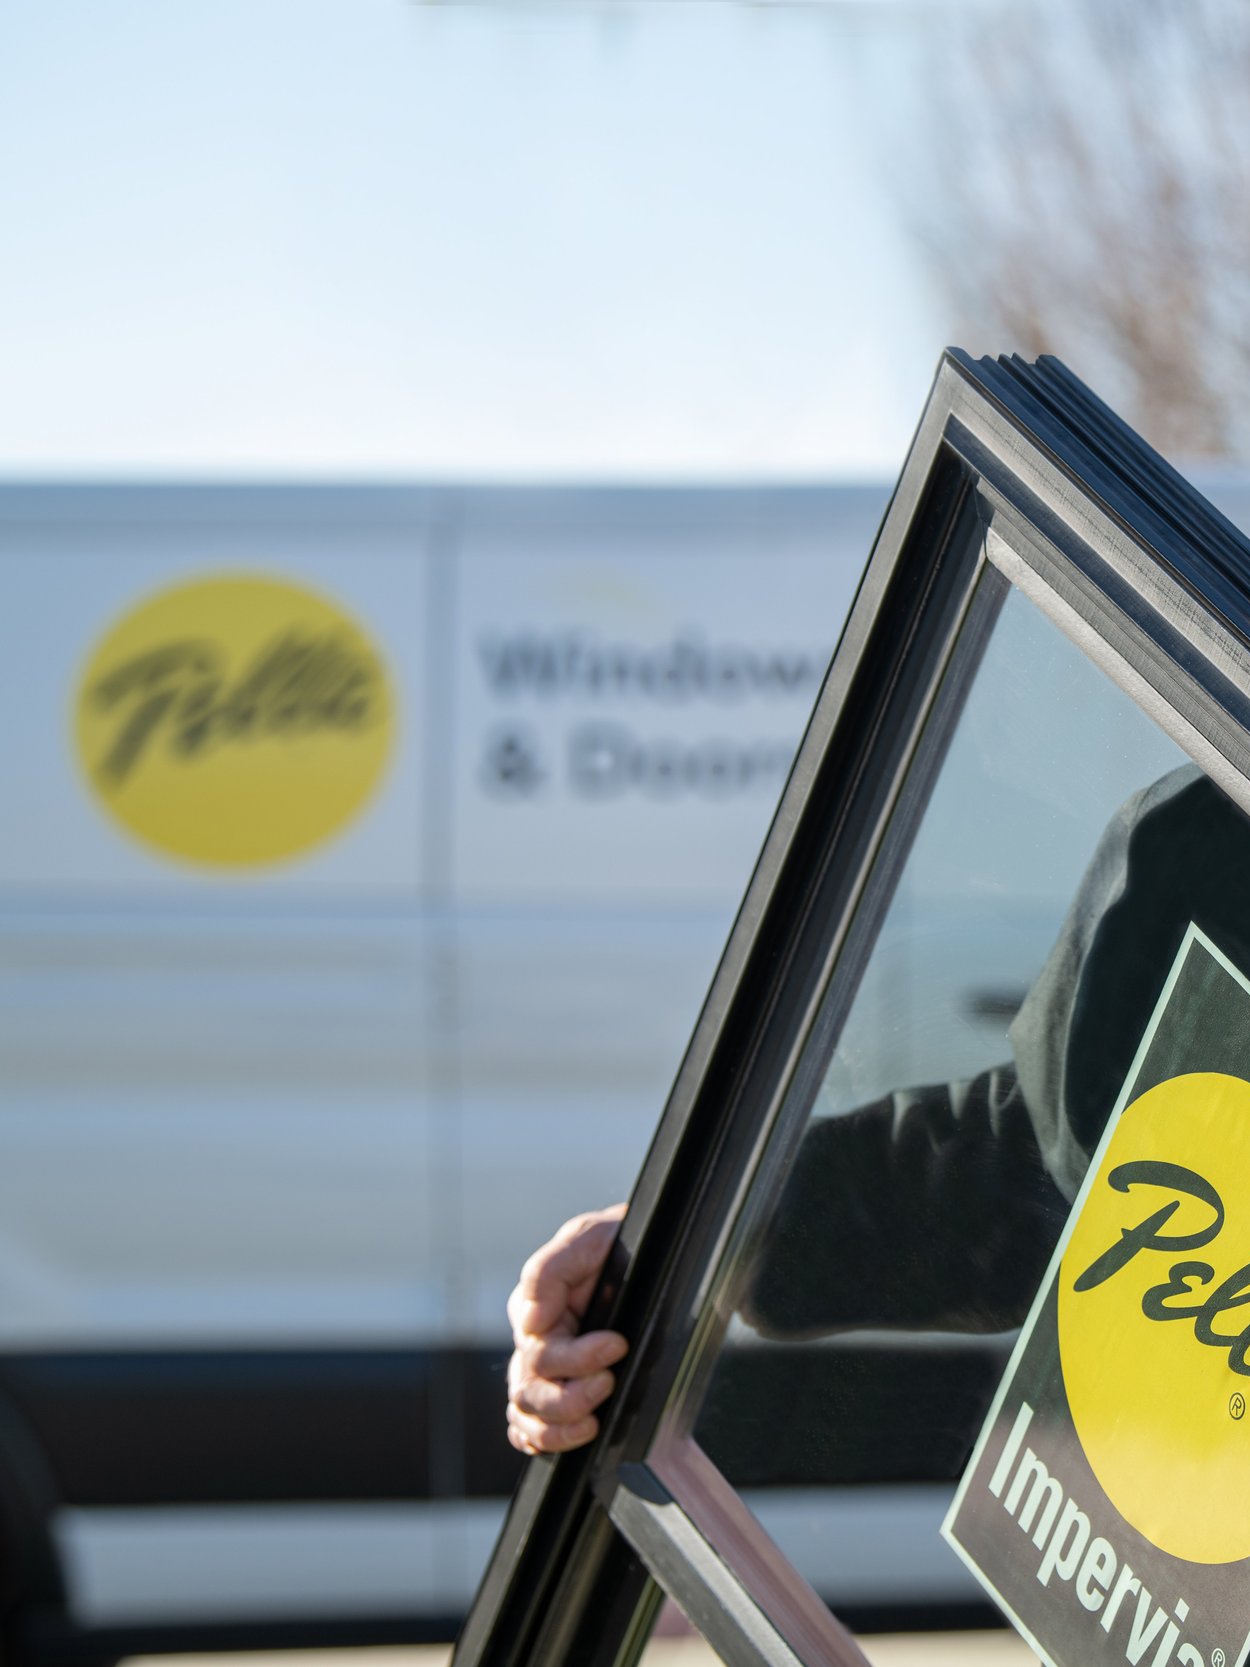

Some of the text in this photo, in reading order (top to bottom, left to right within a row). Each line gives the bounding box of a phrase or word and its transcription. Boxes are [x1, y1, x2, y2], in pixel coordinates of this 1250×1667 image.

[477, 622, 832, 700] Window
[479, 721, 796, 800] & Door
